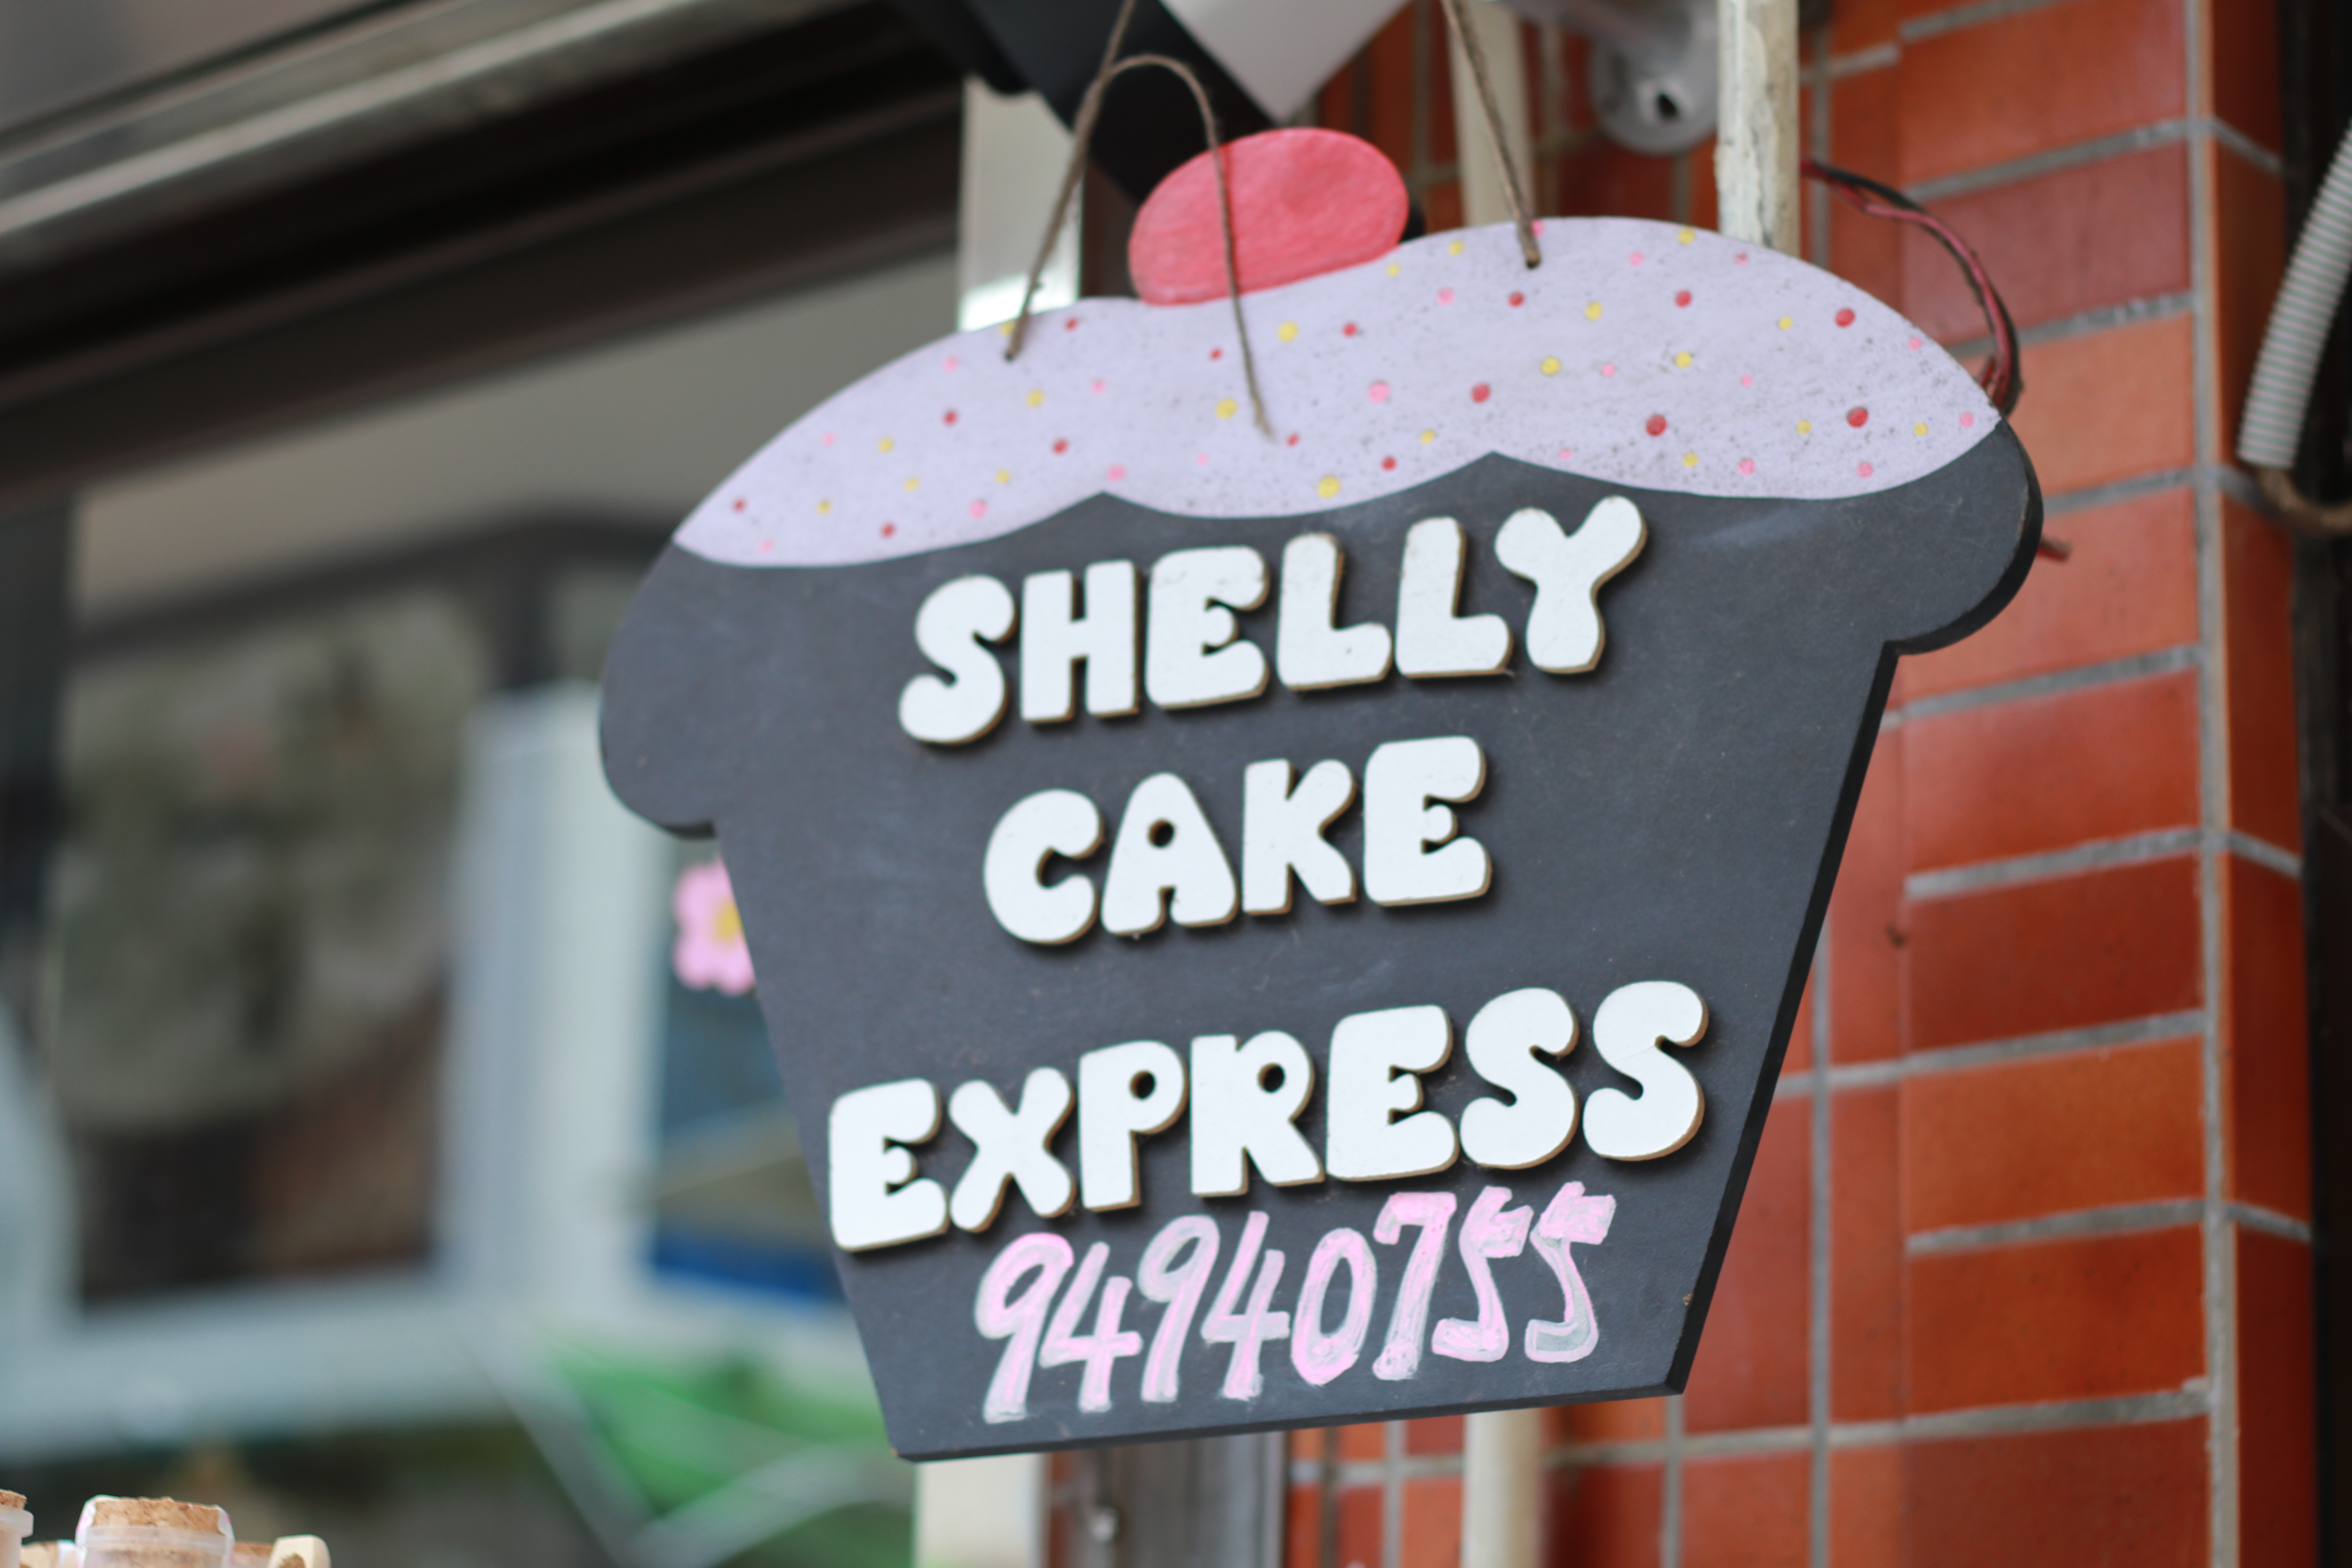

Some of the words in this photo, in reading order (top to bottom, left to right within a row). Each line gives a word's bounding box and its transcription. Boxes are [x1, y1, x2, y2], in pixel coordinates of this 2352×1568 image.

[897, 495, 1648, 746] SHELLY
[982, 735, 1490, 946] CAKE
[828, 980, 1708, 1252] EXPRESS
[974, 1181, 1617, 1425] 94940755
